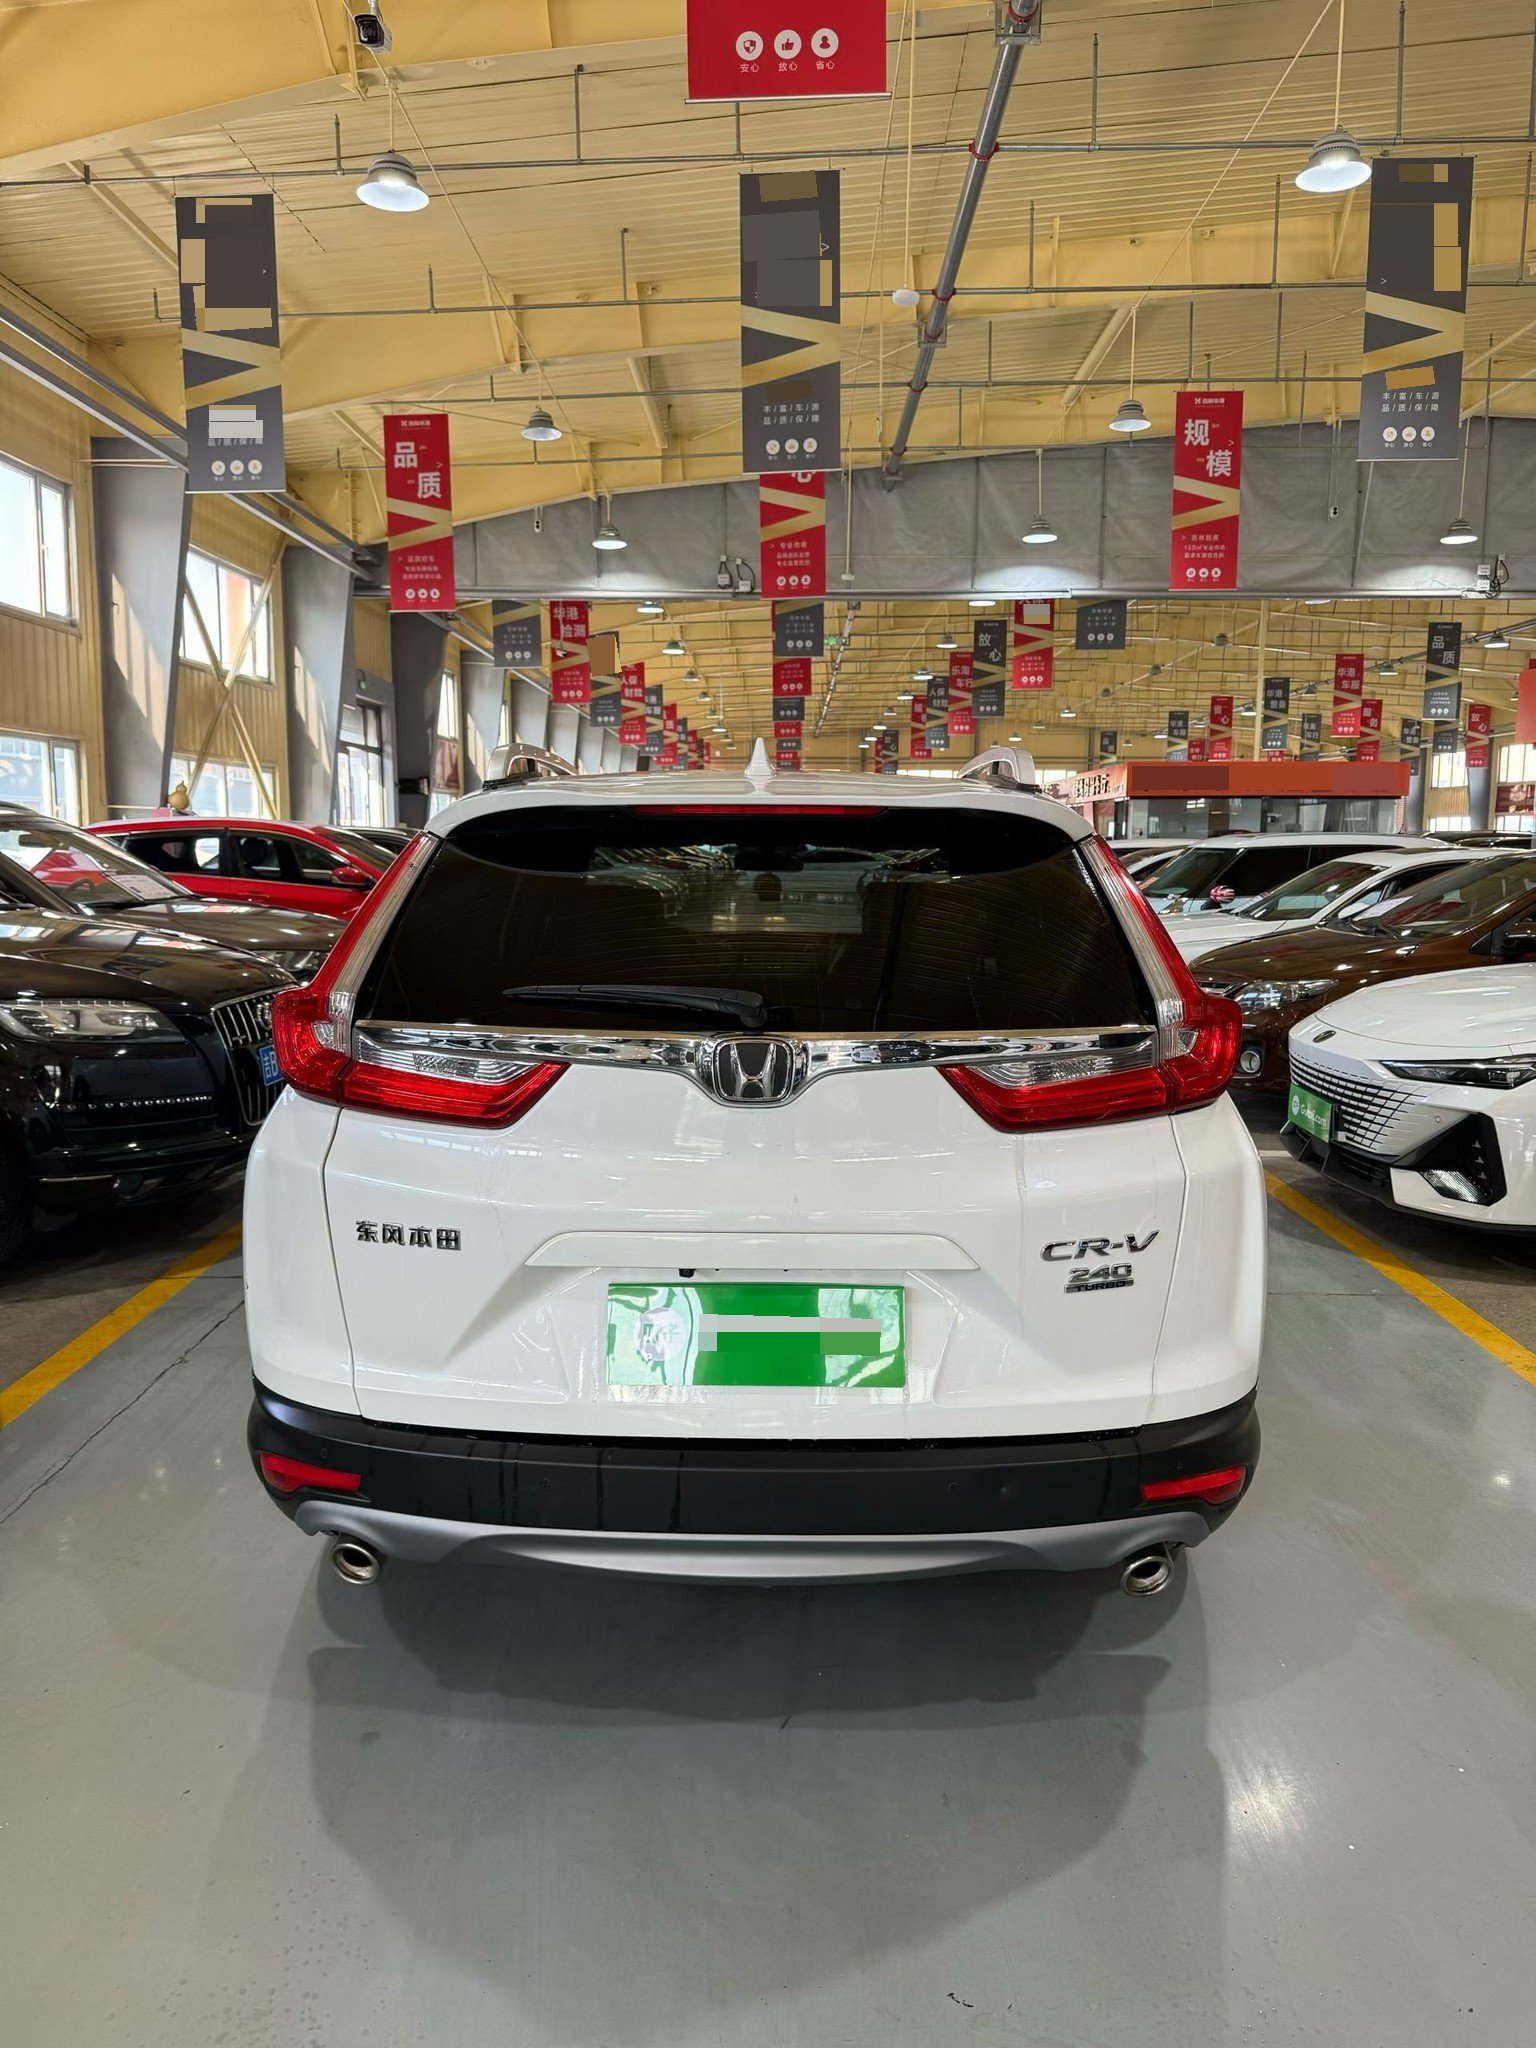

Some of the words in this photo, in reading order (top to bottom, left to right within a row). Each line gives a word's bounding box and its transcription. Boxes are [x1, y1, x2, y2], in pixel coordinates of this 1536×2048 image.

[740, 63, 760, 73] 安心
[778, 62, 798, 72] 放心
[815, 60, 835, 70] 省心
[553, 606, 580, 620] 华港
[562, 623, 587, 638] 检测
[1337, 667, 1356, 678] 华港
[356, 1219, 462, 1252] 东风本田
[1040, 1230, 1160, 1261] CR-V
[1068, 1263, 1133, 1283] 240
